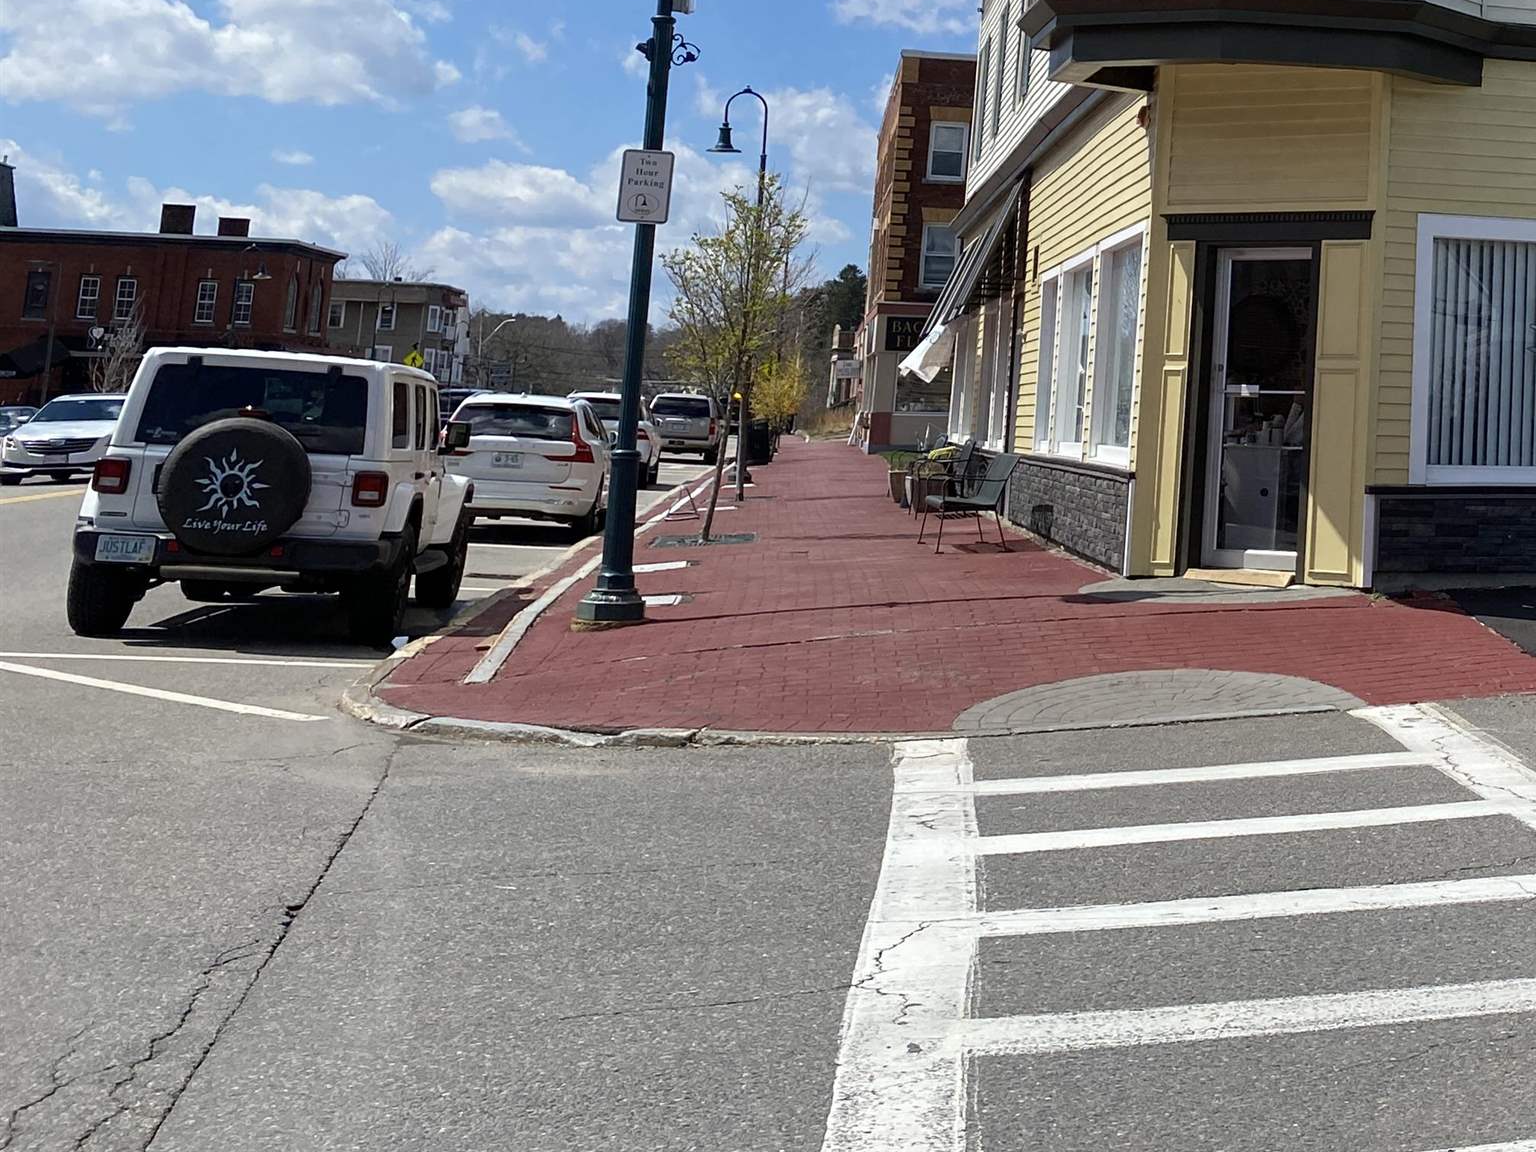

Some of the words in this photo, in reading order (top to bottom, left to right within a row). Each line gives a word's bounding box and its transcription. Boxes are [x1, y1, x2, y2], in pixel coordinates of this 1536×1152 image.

[640, 158, 657, 166] Two
[635, 168, 658, 176] Hour
[628, 178, 664, 189] Parking
[892, 320, 924, 333] BAC
[182, 518, 211, 529] Live
[213, 520, 242, 534] Your
[242, 520, 268, 536] Life
